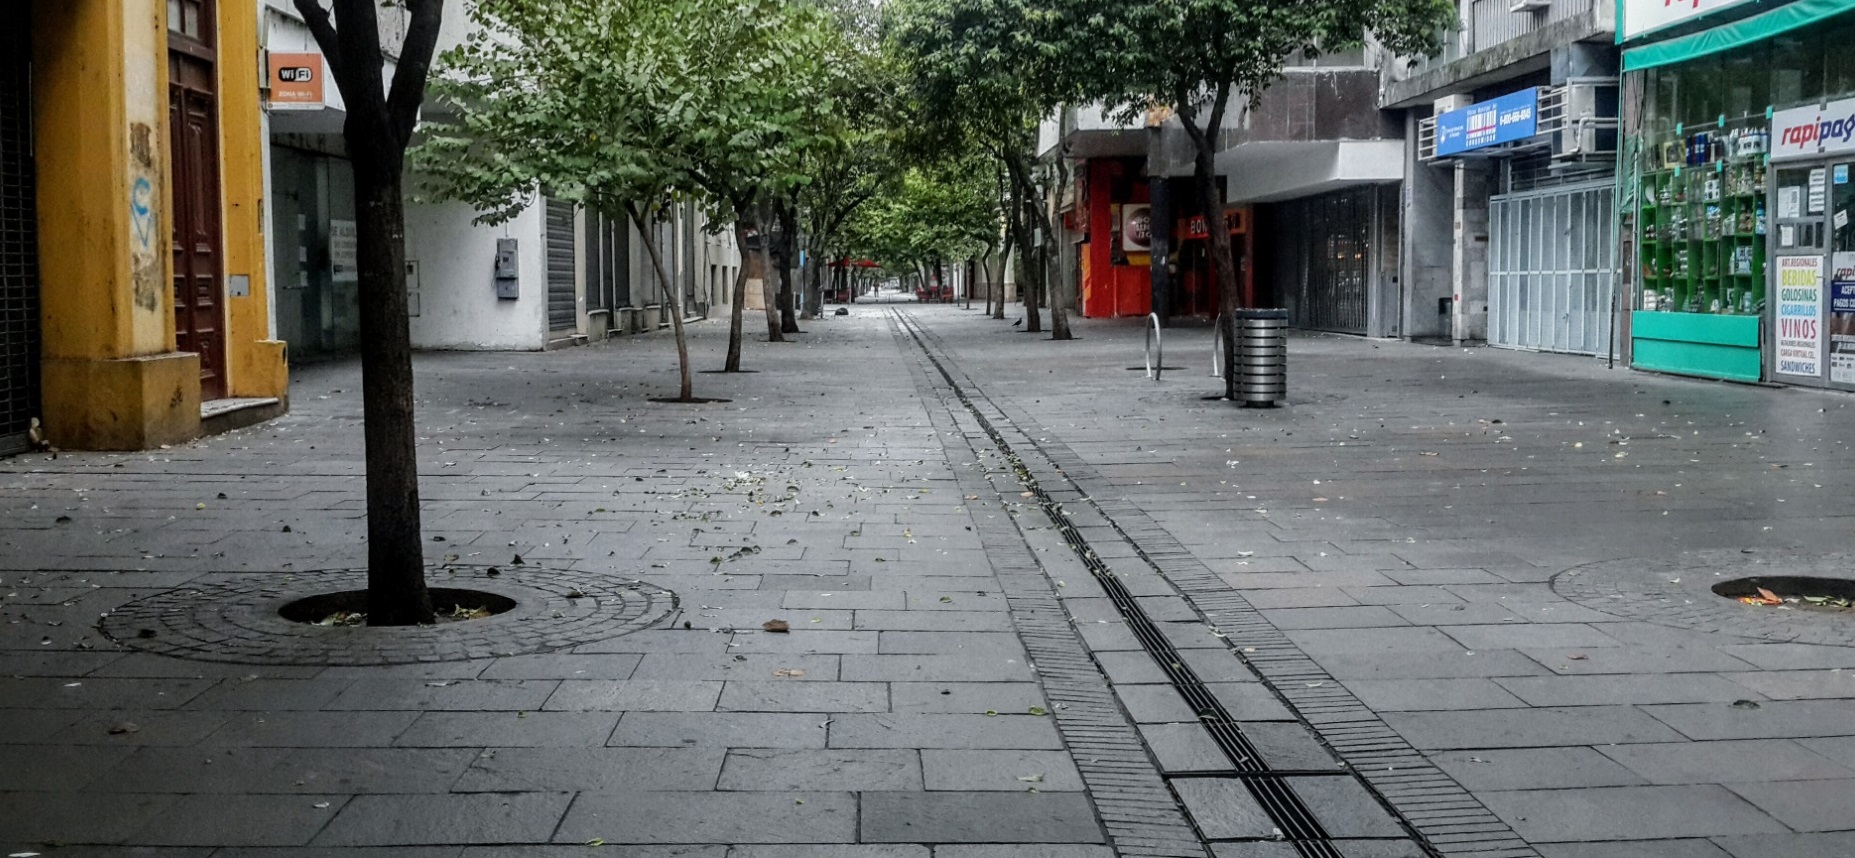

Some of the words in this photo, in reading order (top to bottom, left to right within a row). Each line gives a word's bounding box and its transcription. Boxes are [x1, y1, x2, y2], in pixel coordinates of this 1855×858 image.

[1782, 269, 1817, 287] BEBIDAS
[1781, 288, 1817, 302] GOLOSINAS
[1781, 304, 1816, 317] CIGARRILLOS
[1781, 318, 1817, 339] VINOS
[1781, 360, 1816, 374] SANDWICHES
